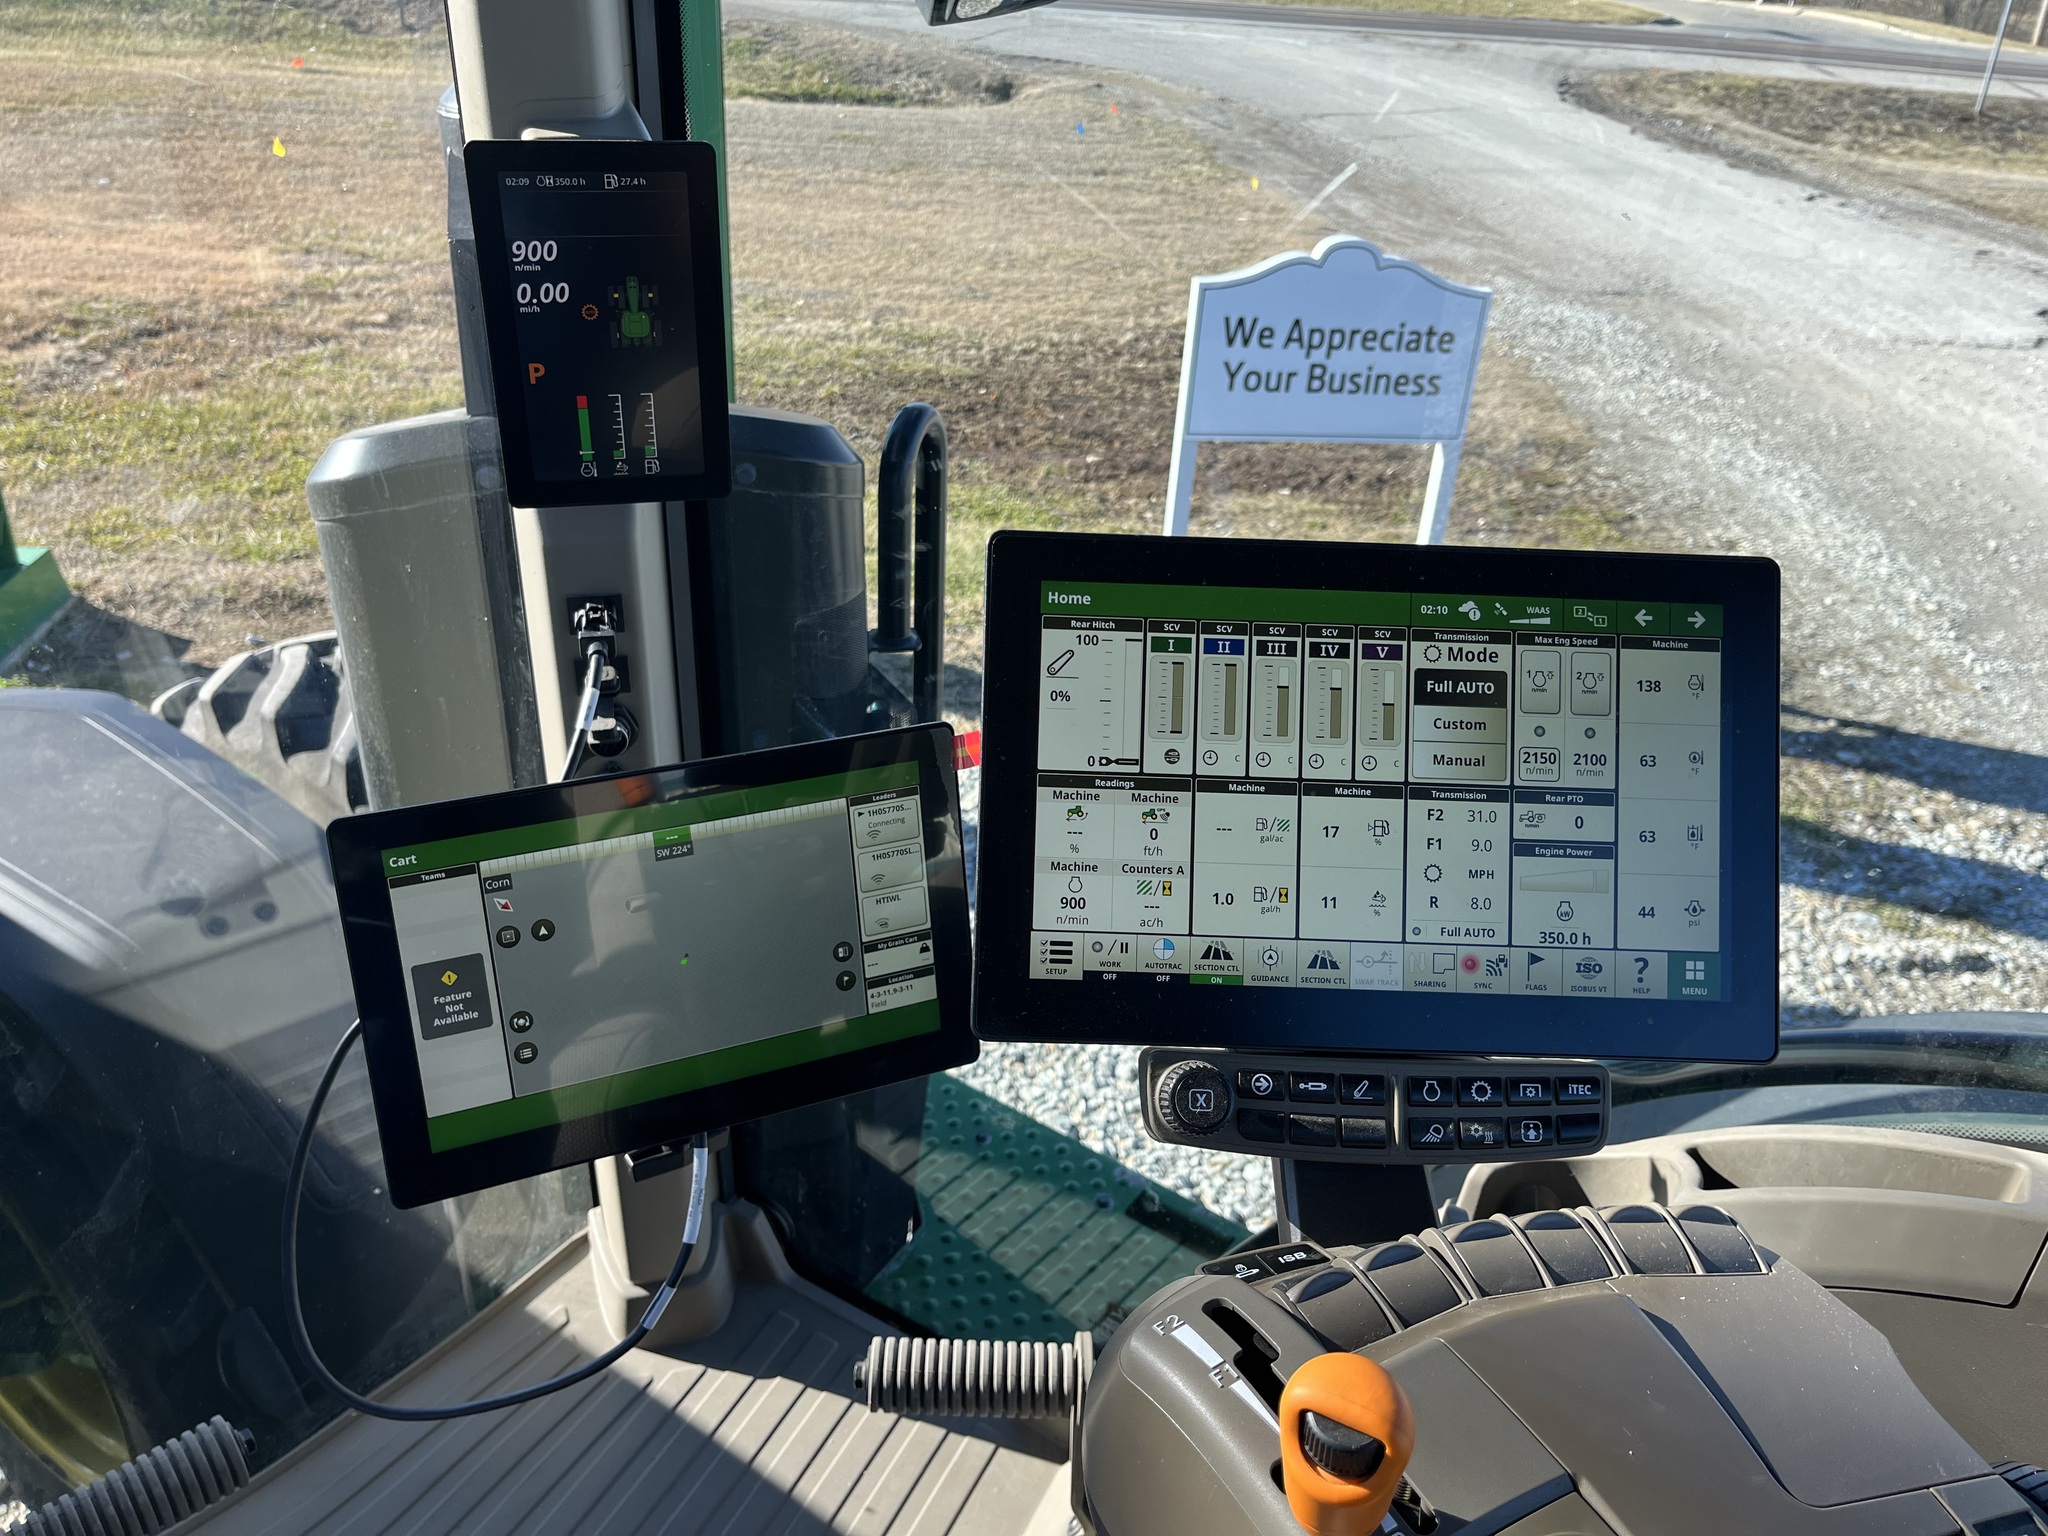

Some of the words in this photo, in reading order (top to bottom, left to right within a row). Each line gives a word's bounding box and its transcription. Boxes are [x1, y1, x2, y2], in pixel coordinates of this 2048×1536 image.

[506, 178, 530, 187] 02:09
[555, 178, 578, 187] 350.0
[580, 178, 586, 186] h
[620, 178, 638, 187] 27.4
[640, 178, 646, 186] h
[512, 240, 558, 262] 900
[515, 263, 541, 272] n/min
[516, 282, 570, 305] 0.00
[520, 305, 540, 314] mi/h
[1224, 316, 1275, 349] We
[1283, 318, 1455, 360] Appreciate
[528, 363, 546, 385] P
[1224, 361, 1298, 393] Your
[1306, 363, 1442, 397] Business
[1048, 591, 1091, 605] Home
[1421, 605, 1448, 615] 02:10
[1071, 620, 1091, 628] Rear
[1093, 621, 1116, 629] Hitch
[1216, 625, 1233, 633] SCV
[1269, 627, 1286, 635] SCV
[1076, 634, 1099, 646] 100
[1434, 633, 1489, 642] Transmission
[1535, 636, 1553, 644] Max
[1554, 637, 1570, 646] Eng
[1572, 638, 1598, 646] Speed
[1652, 640, 1689, 649] Machine
[1320, 645, 1339, 657] IV
[1376, 646, 1389, 659] V
[1448, 647, 1499, 663] Mode
[1427, 680, 1452, 693] Full
[1456, 681, 1495, 694] AUTO
[1636, 680, 1662, 693] 138
[1050, 690, 1071, 702] 0%
[1433, 718, 1487, 731] Custom
[1433, 755, 1485, 767] Manual
[1523, 752, 1557, 765] 2150
[1573, 754, 1607, 766] 2100
[1640, 755, 1657, 768] 63
[1526, 766, 1554, 776] n/min
[1576, 768, 1604, 777] n/min
[1095, 779, 1135, 789] Readings
[1228, 784, 1266, 793] Machine
[873, 792, 897, 801] Leaders
[1052, 791, 1100, 801] Machine
[1335, 788, 1372, 796] Machine
[1431, 791, 1487, 800] Transmission
[1131, 793, 1179, 804] Machine
[1545, 795, 1565, 803] Rear
[1567, 795, 1584, 803] PTO
[1427, 809, 1444, 822] F2
[1467, 810, 1497, 823] 31.0
[868, 817, 906, 829] Connecting
[1574, 816, 1584, 829] 0
[1149, 828, 1159, 841] 0
[1322, 825, 1340, 839] 17
[1639, 831, 1656, 843] 63
[1260, 835, 1284, 843] gal/ac
[1069, 844, 1080, 854] %
[1426, 838, 1442, 851] F1
[1471, 839, 1492, 852] 9.0
[657, 848, 670, 858] SW
[1143, 846, 1163, 857] ft/h
[1535, 848, 1564, 856] Engine
[1566, 848, 1593, 856] Power
[389, 855, 417, 868] Cart
[1050, 862, 1098, 873] Machine
[1121, 864, 1173, 875] Counters
[1176, 866, 1185, 875] A
[421, 872, 446, 881] Teams
[1468, 869, 1494, 880] MPH
[485, 878, 510, 890] Corn
[1060, 897, 1086, 910] 900
[1212, 893, 1234, 906] 1.0
[1321, 896, 1338, 909] 11
[1430, 896, 1439, 908] R
[1470, 897, 1492, 910] 8.0
[1260, 905, 1281, 914] gal/h
[1638, 906, 1656, 919] 44
[1056, 915, 1089, 926] n/min
[1140, 918, 1164, 928] ac/h
[1688, 919, 1700, 928] psi
[1440, 927, 1461, 938] Full
[1464, 928, 1496, 938] AUTO
[1539, 932, 1578, 945] 350.0
[1583, 932, 1591, 945] h
[1145, 962, 1182, 970] AUTOTRAC
[1194, 964, 1225, 972] SECTION
[1575, 962, 1603, 974] ISO
[889, 974, 914, 983] Location
[1103, 973, 1117, 981] OFF
[1251, 975, 1290, 983] GUIDANCE
[434, 990, 472, 1005] Feature
[1682, 988, 1708, 996] MENU
[445, 1003, 464, 1013] Not
[871, 1000, 887, 1009] Field
[433, 1010, 479, 1027] Available
[1568, 1084, 1592, 1095] iTEC
[1278, 1251, 1307, 1264] ISB
[1152, 1314, 1185, 1336] F2
